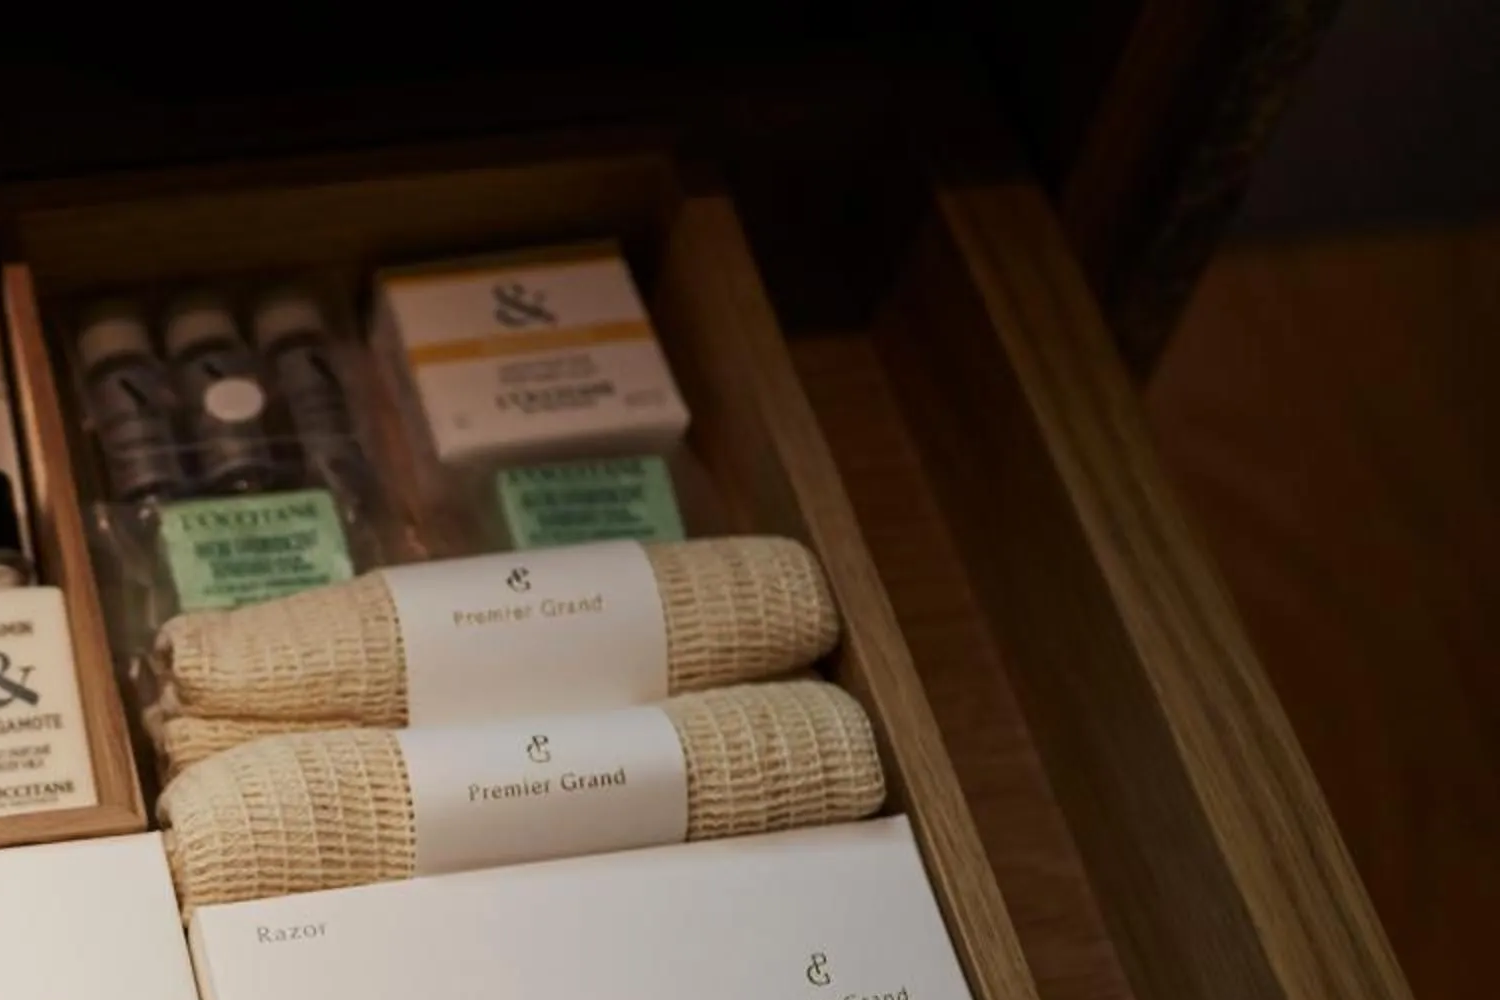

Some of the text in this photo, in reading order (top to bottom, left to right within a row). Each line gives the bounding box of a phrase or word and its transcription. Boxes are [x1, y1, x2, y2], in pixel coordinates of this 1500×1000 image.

[453, 594, 604, 627] Premier Grand
[467, 767, 627, 801] Premier Grand
[255, 921, 328, 944] Razor
